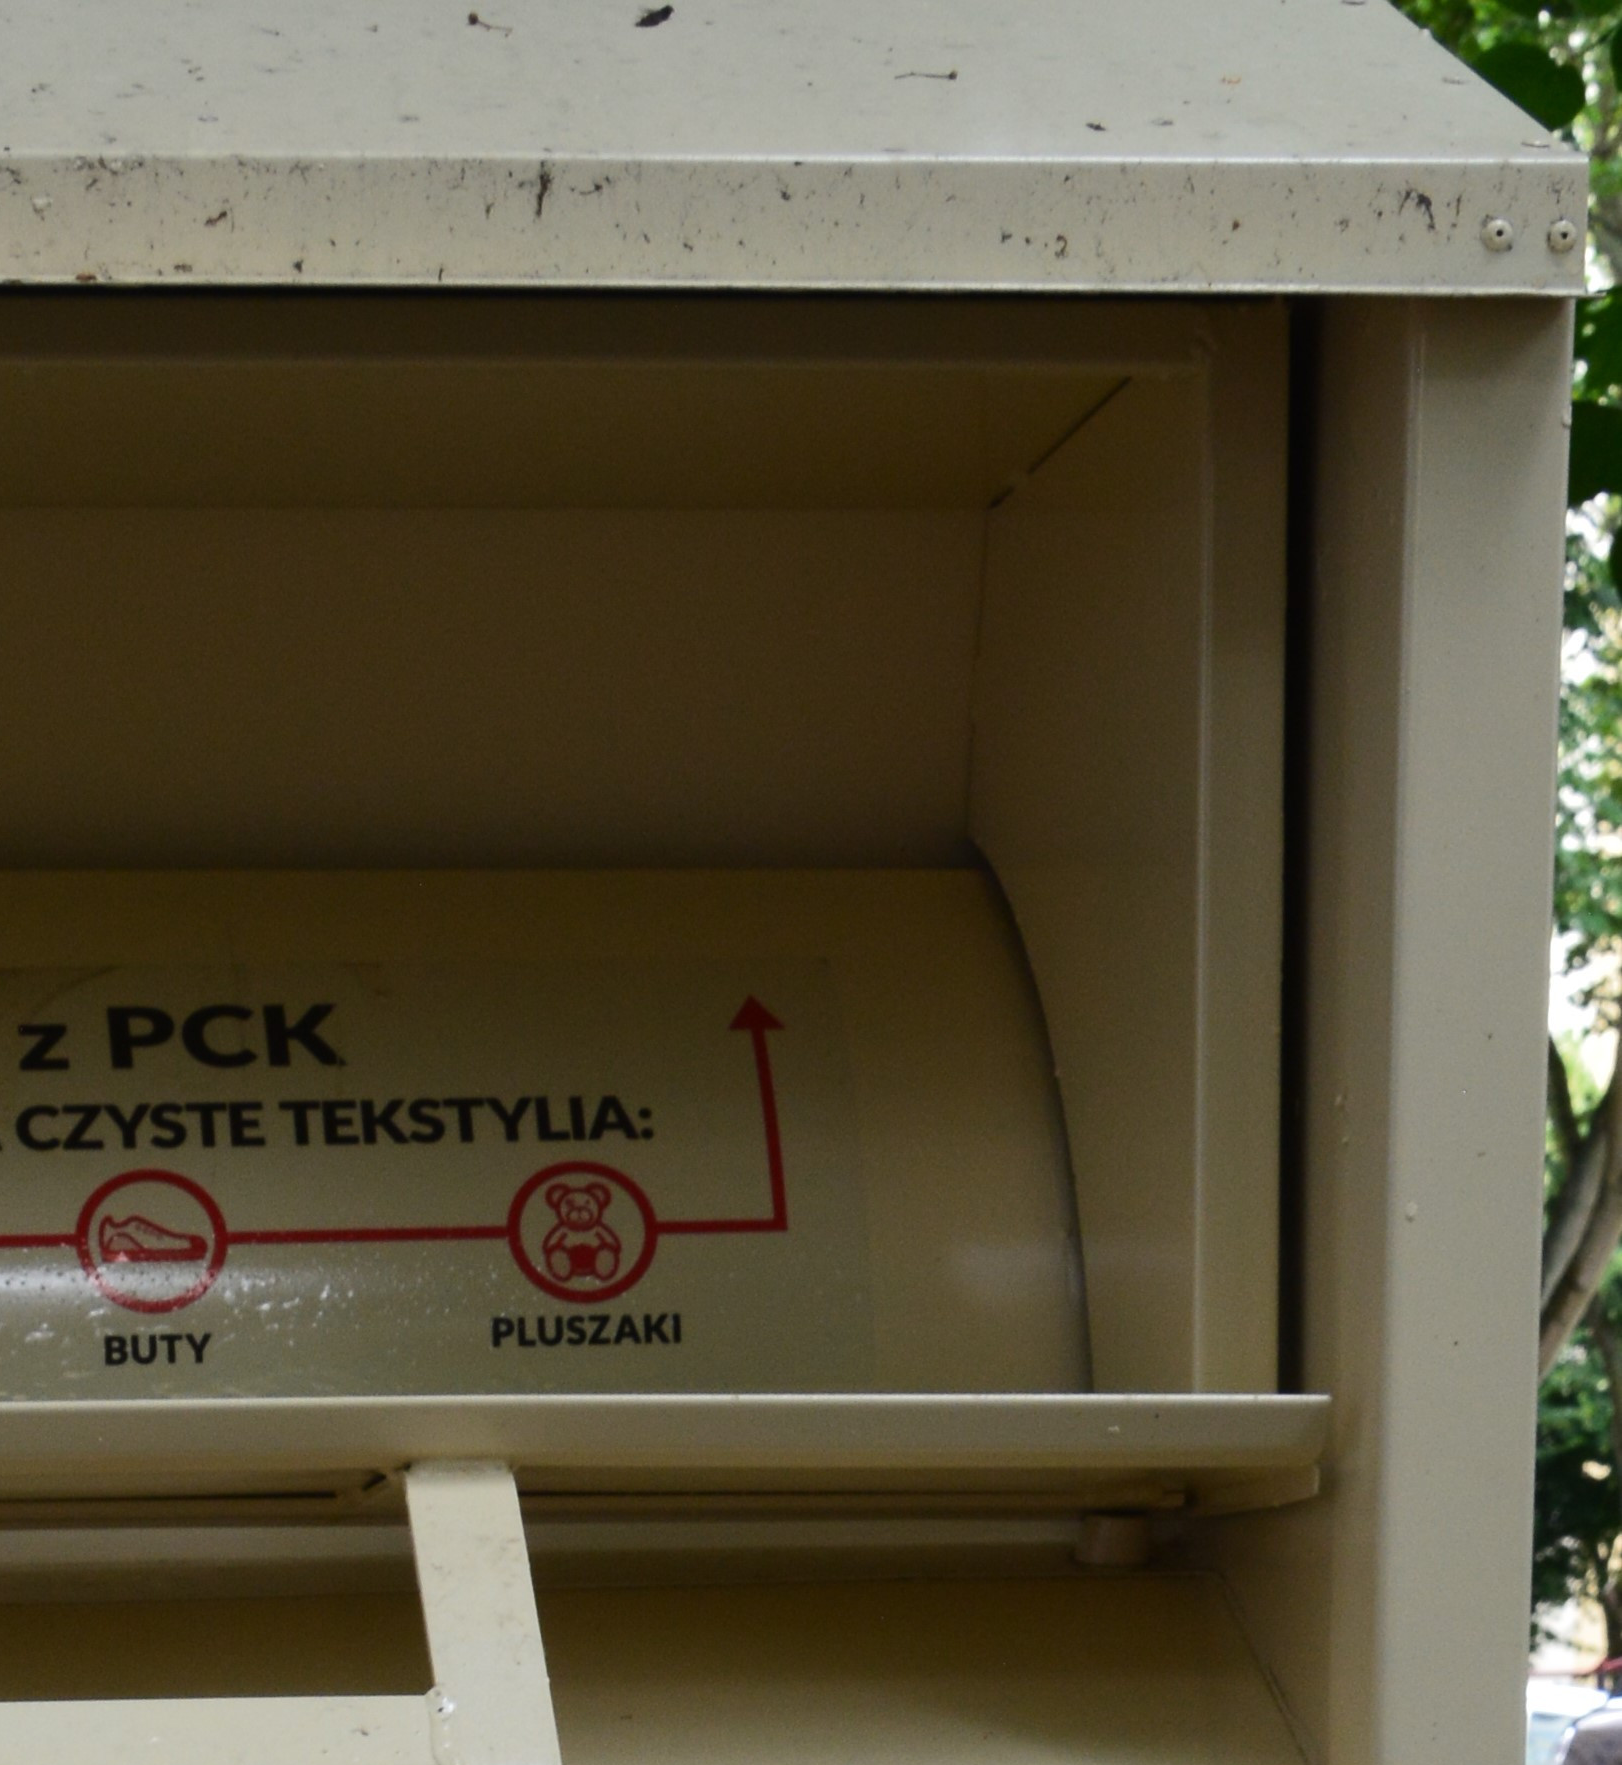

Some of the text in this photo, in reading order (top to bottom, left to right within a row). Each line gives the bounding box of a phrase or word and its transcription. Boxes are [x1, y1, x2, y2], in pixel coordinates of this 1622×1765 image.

[18, 1024, 69, 1070] z
[107, 1004, 345, 1068] PCK
[15, 1101, 266, 1151] CZYSTE
[279, 1095, 653, 1145] TEKSTYLIA:
[104, 1333, 211, 1366] BUTY
[492, 1313, 681, 1347] PLUSZAKI
